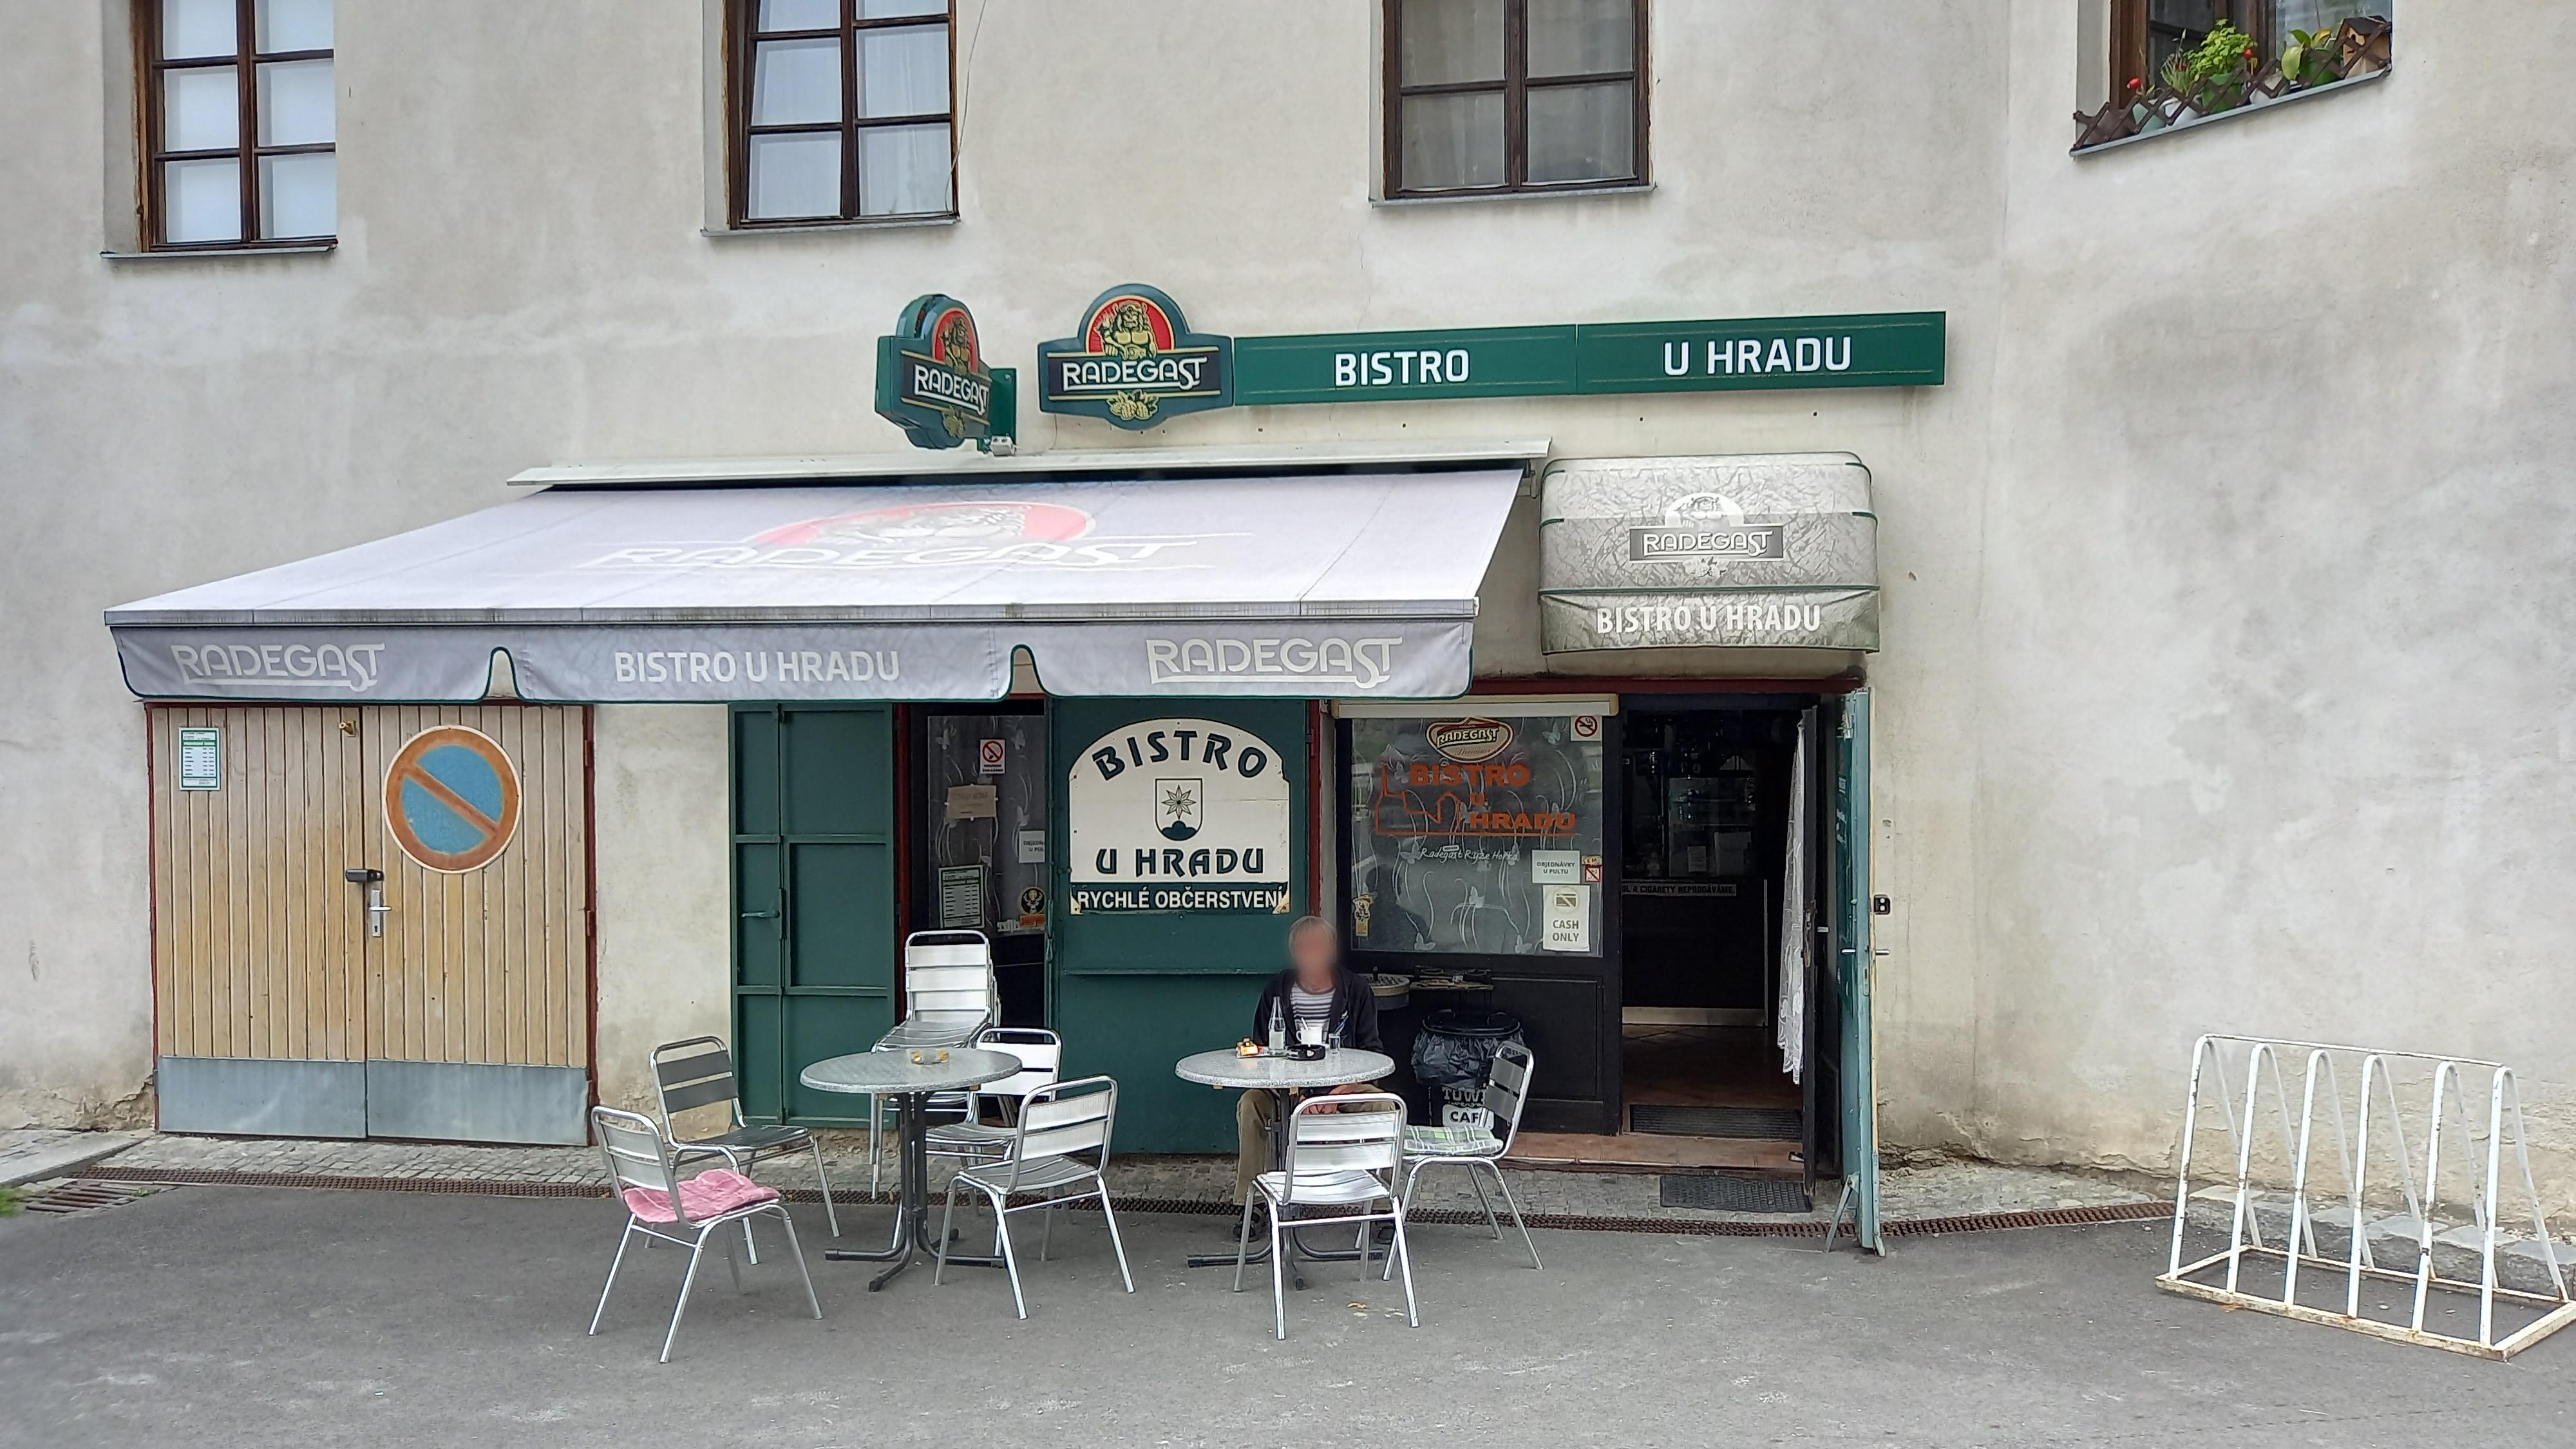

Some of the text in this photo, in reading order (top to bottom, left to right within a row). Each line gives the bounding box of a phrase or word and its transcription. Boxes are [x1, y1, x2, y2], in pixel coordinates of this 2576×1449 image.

[1062, 355, 1209, 392] RADEGAST
[1334, 336, 1852, 386] BISTRO U HRADU
[914, 364, 990, 416] RADEGAST
[589, 540, 1198, 567] RADEGAST
[1643, 529, 1774, 557] RADEGAST
[1597, 605, 1821, 634] BISTRO U HRADU
[170, 643, 385, 693] RADEGAST
[614, 650, 902, 685] BISTRO U HRADU
[1146, 636, 1403, 689] RADEGAST
[1437, 728, 1499, 748] RADEGAST
[1092, 730, 1267, 781] BISTRO
[1409, 764, 1531, 787] BISTRO
[1470, 792, 1486, 806] U
[1469, 812, 1577, 830] HRADU
[1095, 848, 1264, 878] U HRADU
[1417, 848, 1464, 864] Radegast
[1077, 886, 1283, 909] RYCHLÉ OBČERSTVENÍ
[1553, 920, 1579, 929] CASH
[1553, 933, 1579, 942] ONLY
[1449, 1110, 1479, 1124] CAF
